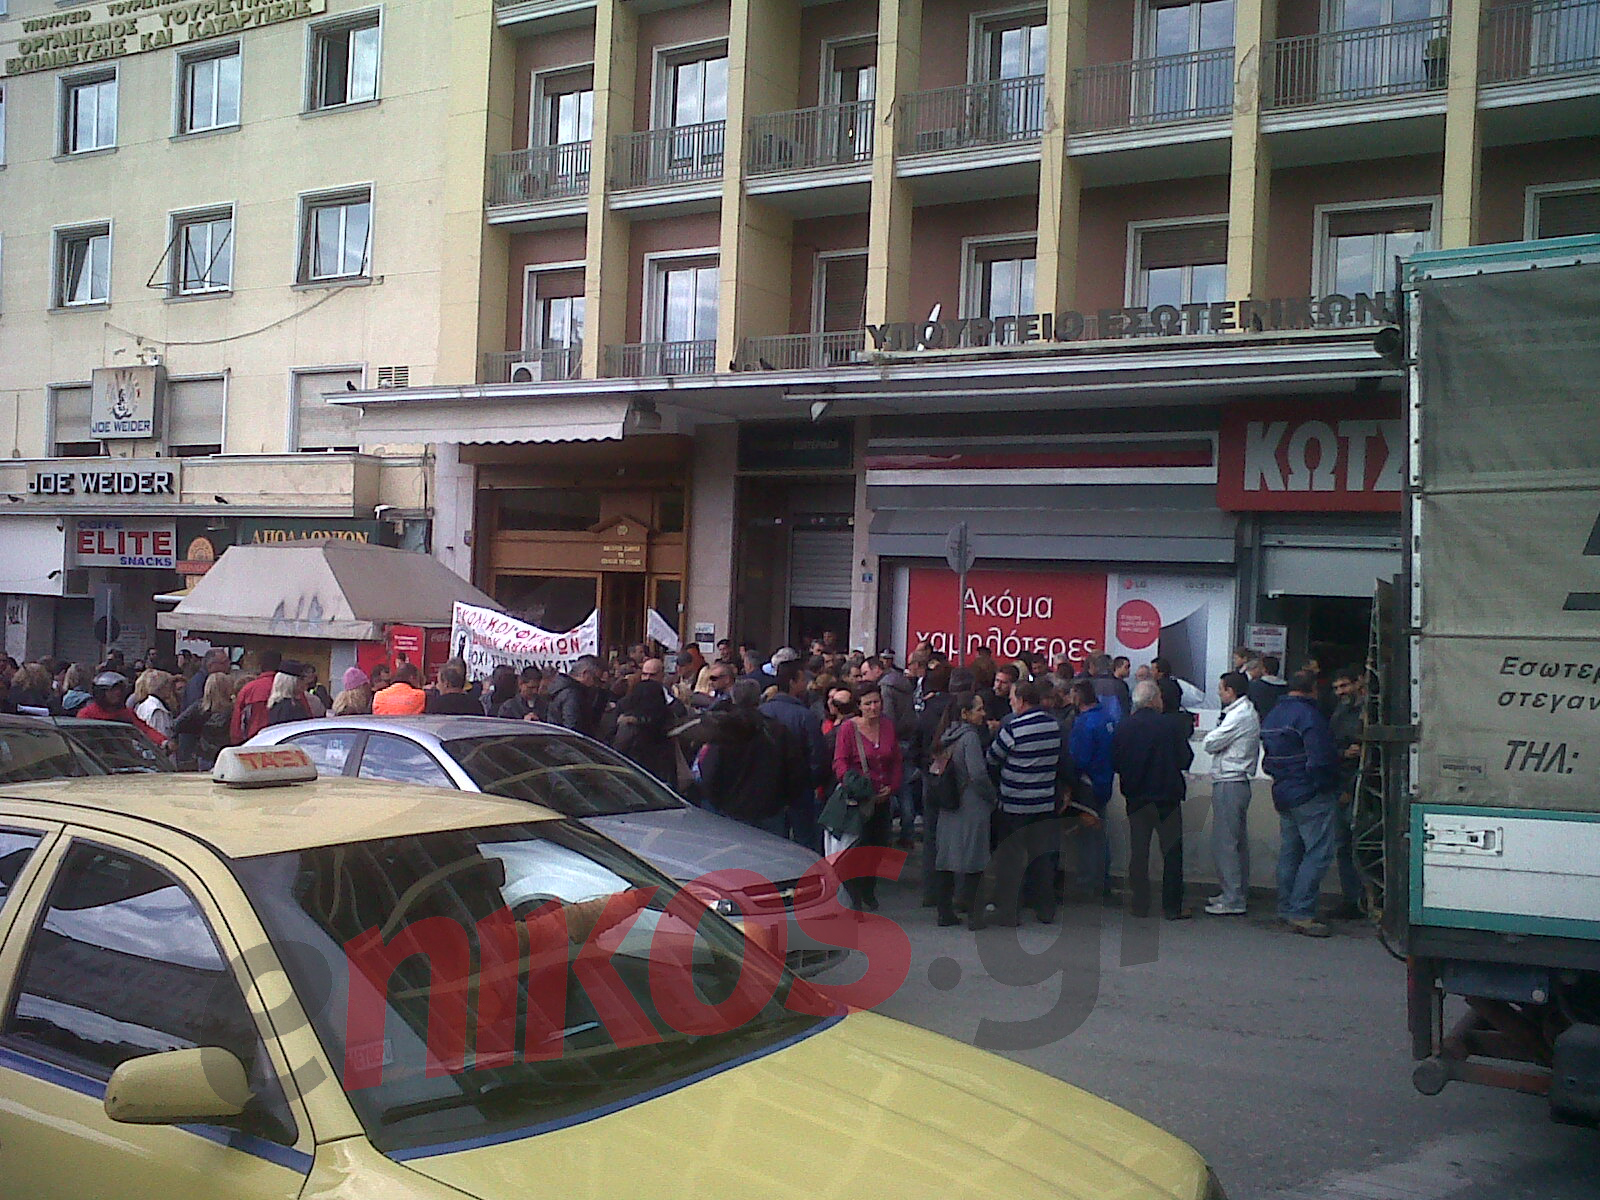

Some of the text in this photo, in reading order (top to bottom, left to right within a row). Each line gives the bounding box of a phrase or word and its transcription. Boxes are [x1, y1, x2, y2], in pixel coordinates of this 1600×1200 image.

[5, 0, 312, 74] ΕΚΠΑΙΔΕΥΣΗΣ ΚΑΙ ΚΑΤΑΡΤΙΣΗΣ
[19, 18, 138, 55] ΟΡΓΑΝΙΣΜΟΣ
[866, 291, 1397, 351] ΥΠΟΥΡΓΕΙΟ ΕΣΩΤΕΡΙΚΩΝ
[92, 420, 151, 433] JOE WEIDER
[27, 472, 175, 495] JOE WEIDER
[77, 531, 172, 555] ELITE
[120, 556, 172, 567] SNACKS
[963, 588, 1053, 624] Ακόμα
[1504, 740, 1580, 774] ΤΗΛ:
